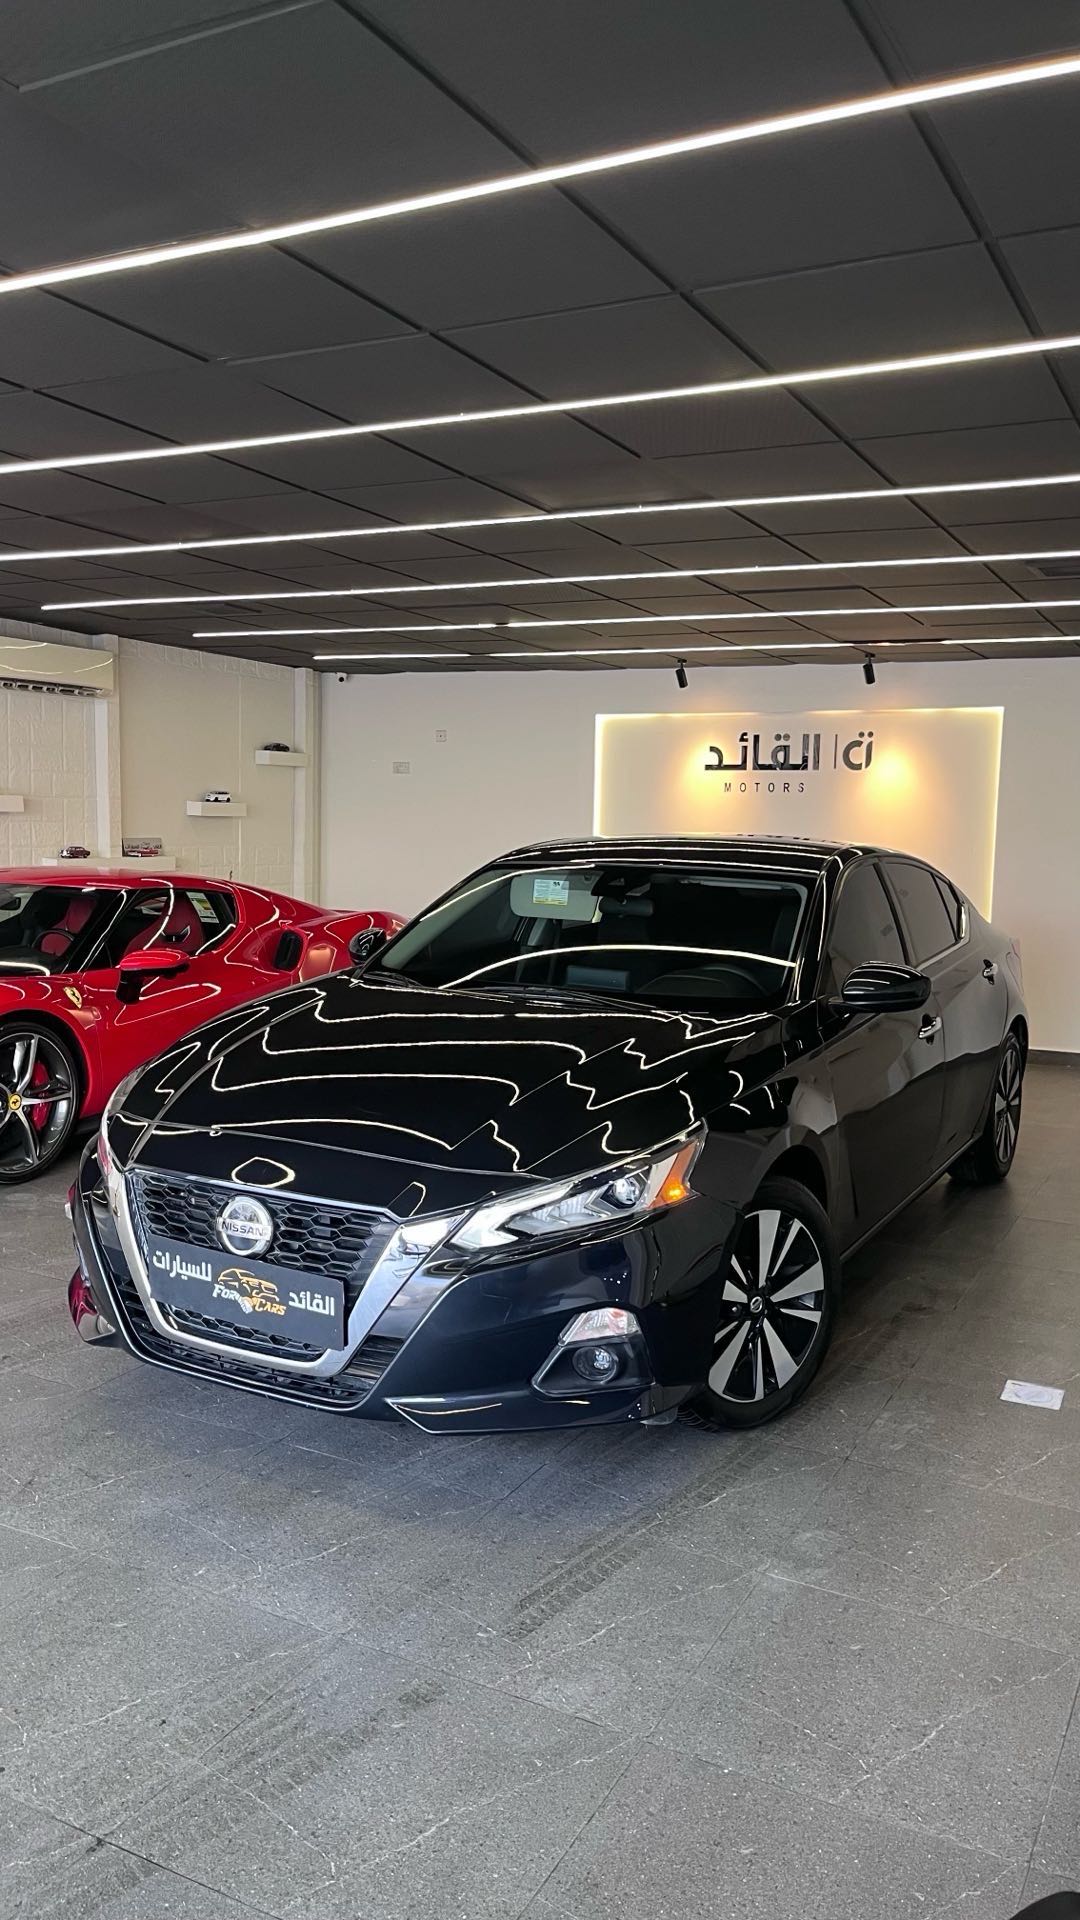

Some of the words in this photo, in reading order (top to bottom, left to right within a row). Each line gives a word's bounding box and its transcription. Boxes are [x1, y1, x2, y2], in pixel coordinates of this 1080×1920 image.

[704, 732, 821, 771] القائد
[724, 782, 804, 793] MOTORS
[220, 1220, 265, 1238] NISSAN
[152, 1250, 212, 1282] للسيارات
[254, 1298, 287, 1316] CARS
[288, 1291, 335, 1316] القائد
